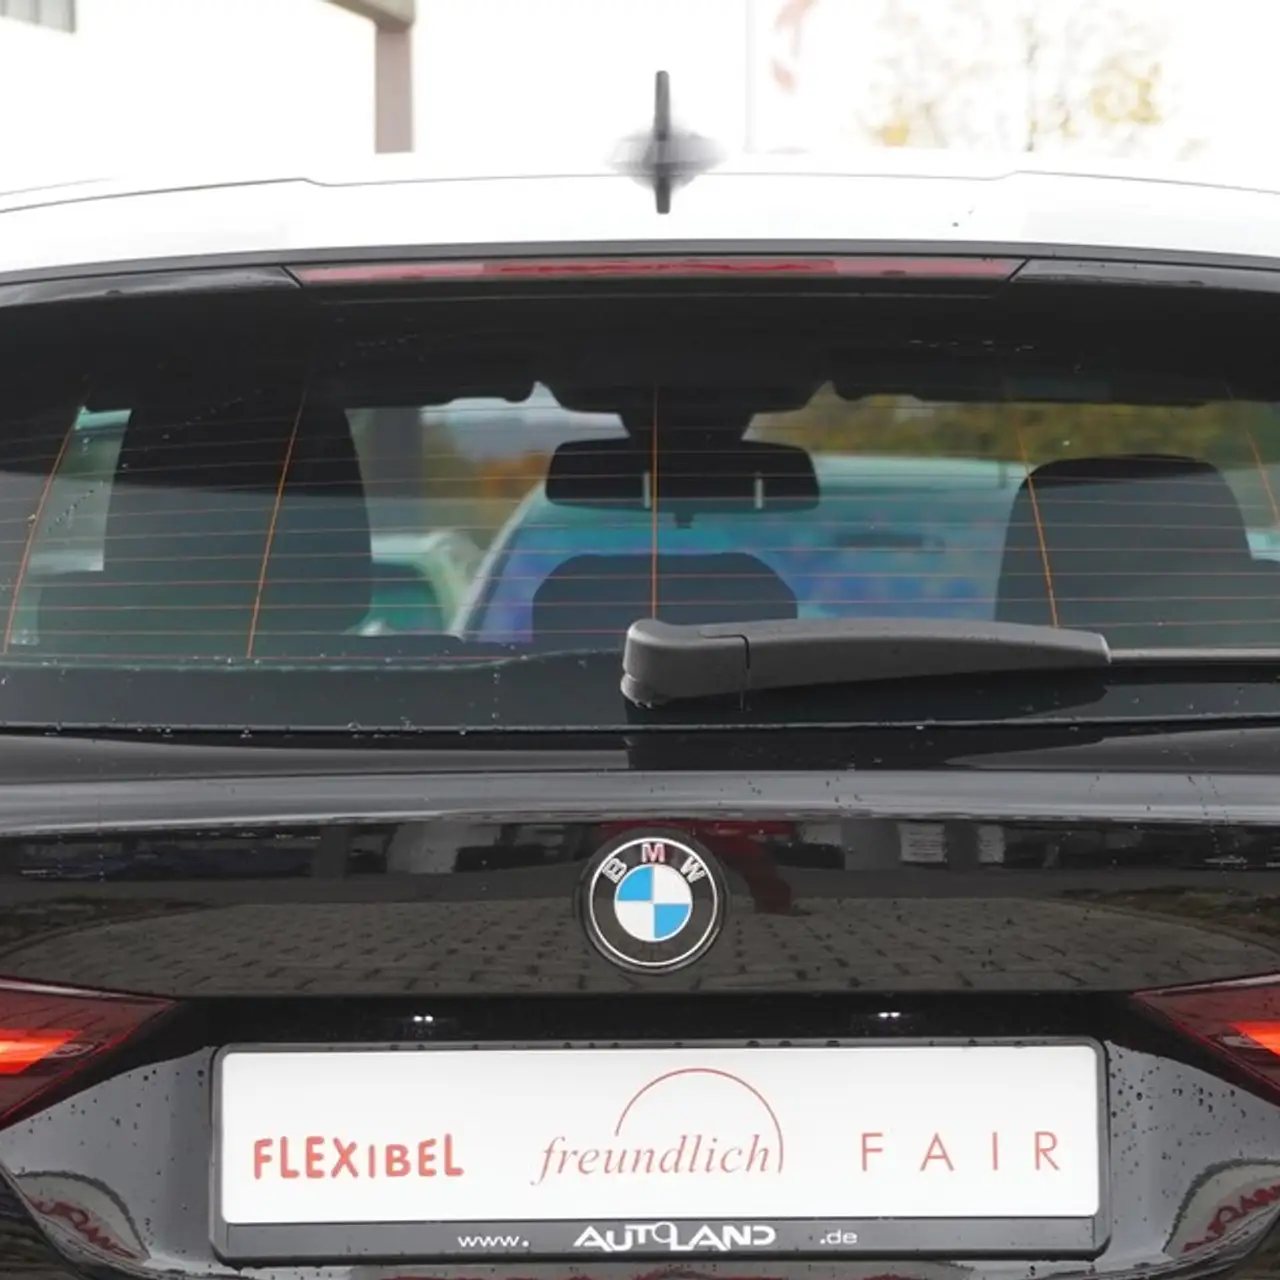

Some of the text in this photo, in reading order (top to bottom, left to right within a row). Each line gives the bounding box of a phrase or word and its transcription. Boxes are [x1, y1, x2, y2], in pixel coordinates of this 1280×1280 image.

[601, 842, 708, 885] BMW
[253, 1130, 1062, 1186] FLEXIBEL freundlich FAIR
[457, 1221, 858, 1252] www. AUTOLAND .de
